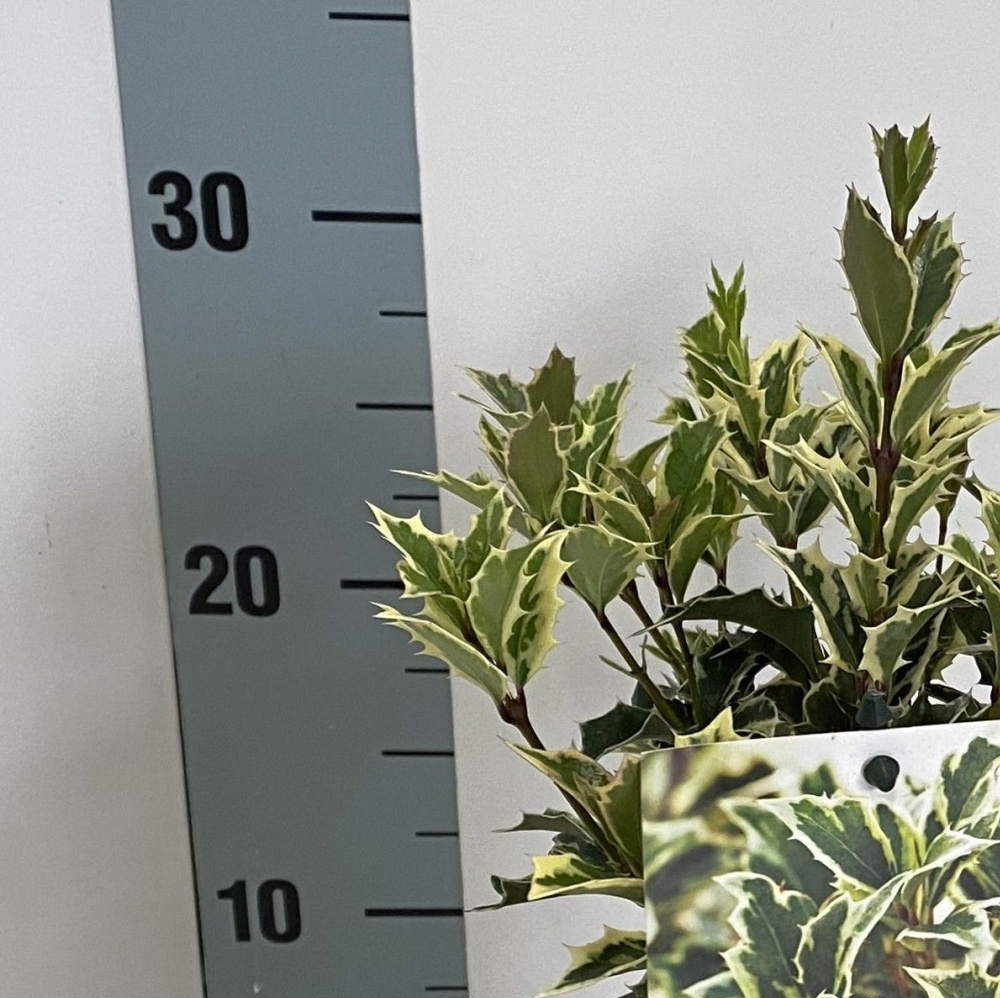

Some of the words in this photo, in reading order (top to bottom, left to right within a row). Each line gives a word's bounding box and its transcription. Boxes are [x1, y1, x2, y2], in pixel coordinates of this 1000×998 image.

[148, 170, 249, 252] 30
[184, 545, 280, 617] 20
[217, 879, 302, 943] 10
